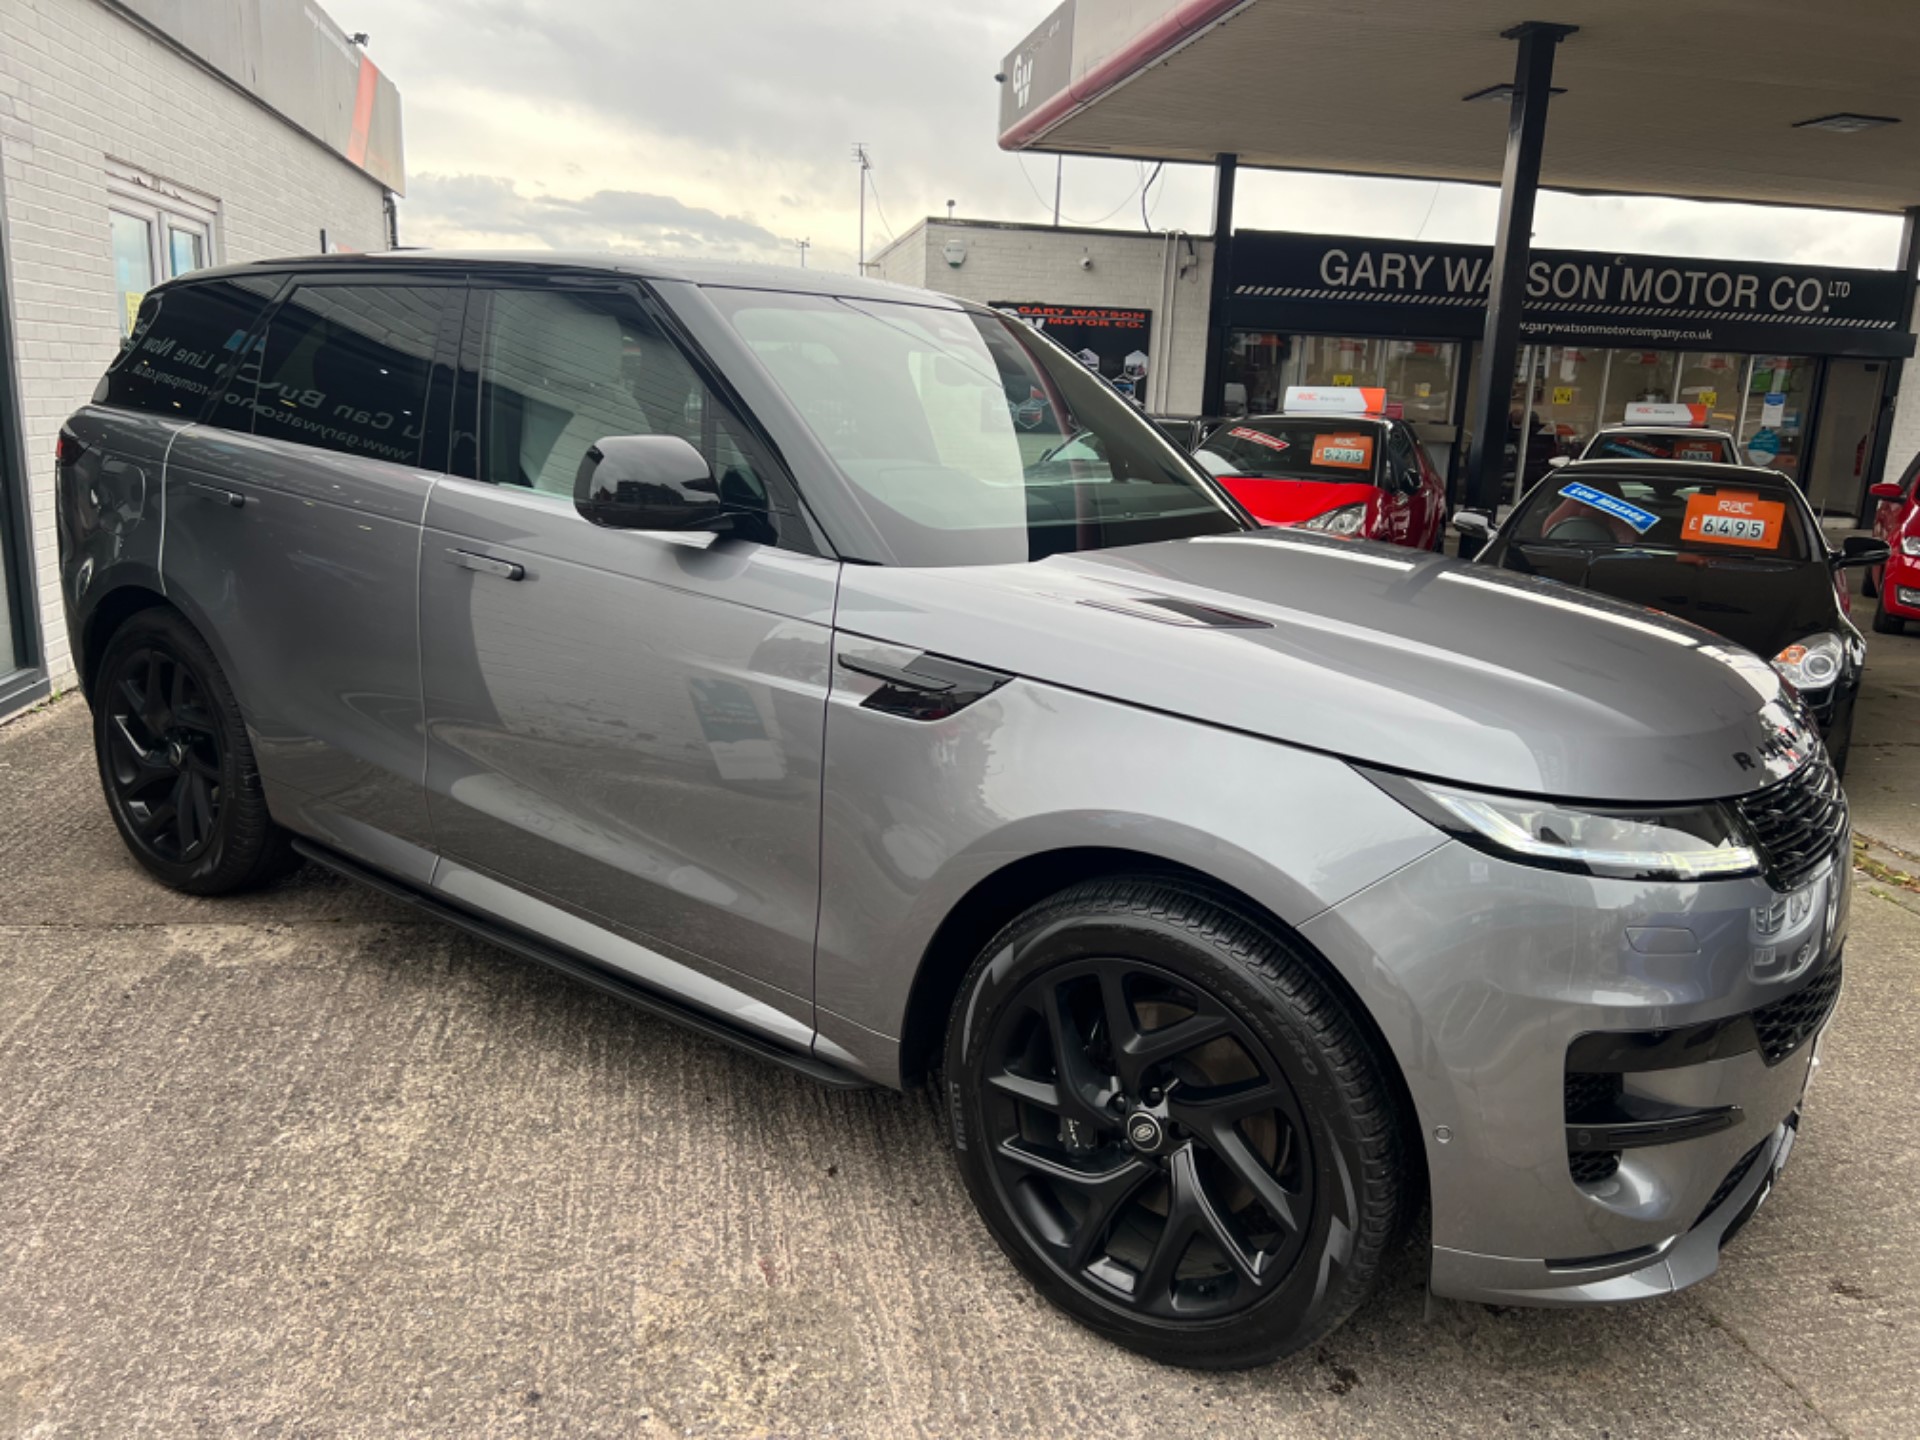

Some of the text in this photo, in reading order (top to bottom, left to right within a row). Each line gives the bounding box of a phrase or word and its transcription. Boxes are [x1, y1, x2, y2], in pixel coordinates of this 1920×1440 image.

[1320, 249, 1850, 313] GARY WASON MOTOR CO. LTD
[1018, 306, 1145, 319] GARY WATSON
[1048, 317, 1144, 329] MOTOR CO.
[1519, 320, 1713, 341] w.garywatsonmotorcompany.co.uk
